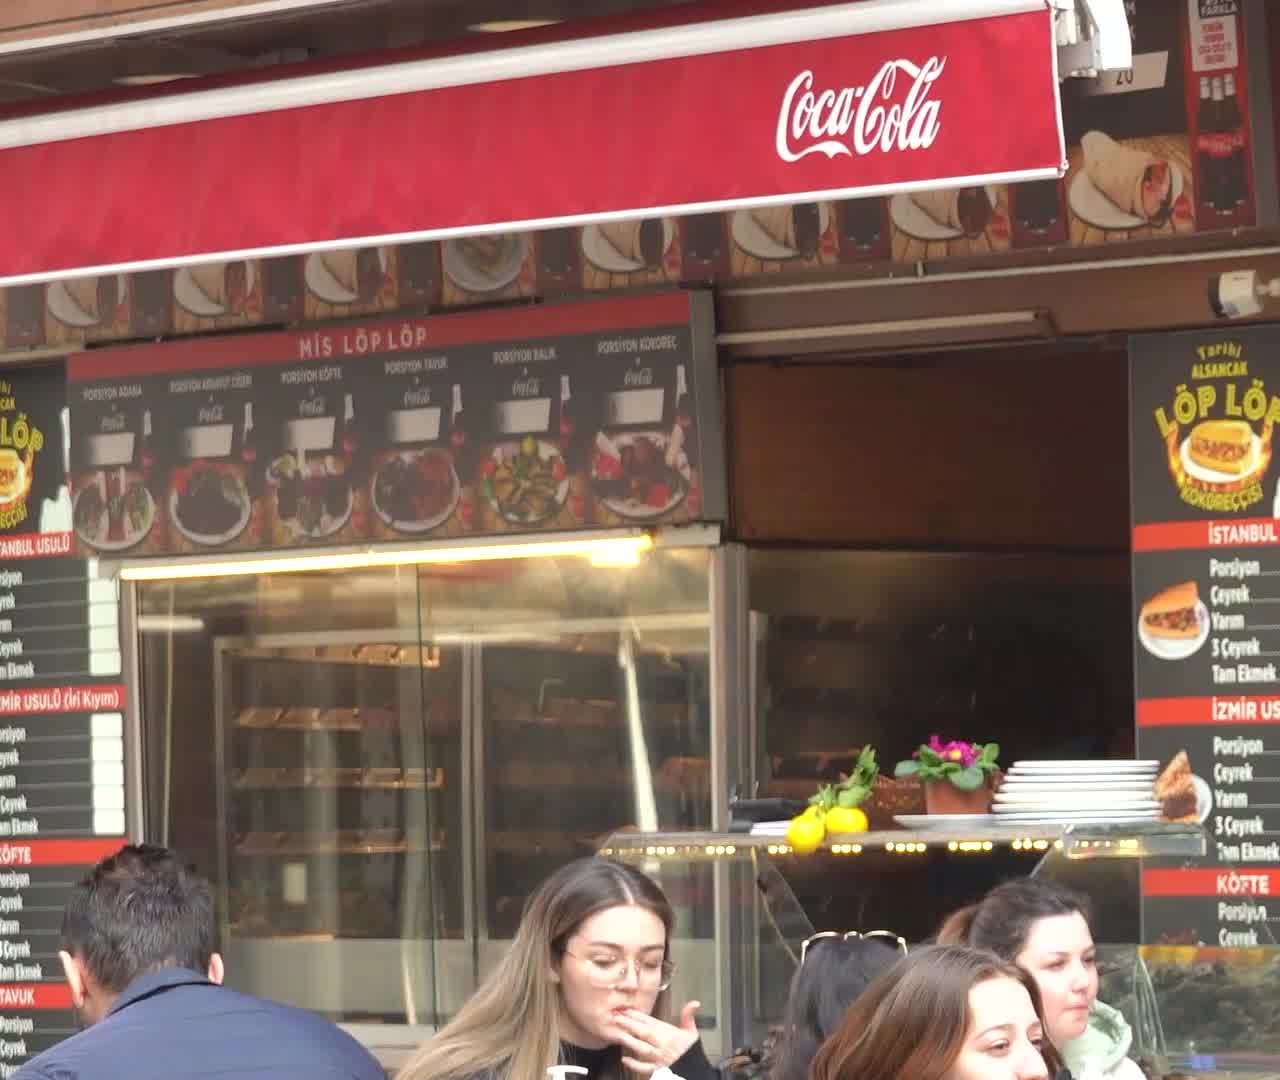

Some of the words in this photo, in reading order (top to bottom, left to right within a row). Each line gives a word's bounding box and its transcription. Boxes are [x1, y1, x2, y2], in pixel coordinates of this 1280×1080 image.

[776, 55, 948, 162] Coca-Cola
[299, 335, 334, 359] MİS
[344, 329, 382, 354] LÖP
[388, 324, 427, 350] LÖP
[1197, 341, 1242, 360] Tarihi
[1191, 360, 1249, 380] ALSANCAK
[1155, 384, 1217, 438] LÖP
[36, 533, 71, 554] USULÜ
[1208, 520, 1278, 545] İSTANBUL
[1208, 557, 1261, 580] Porsiyon
[1210, 584, 1251, 607] Çeyrek
[1211, 612, 1245, 631] Yarım
[1221, 637, 1260, 660] Çeyrek
[8, 659, 35, 680] Ekmek
[1211, 665, 1236, 685] Tam
[1237, 662, 1278, 684] Ekmek
[24, 687, 62, 709] USULÜ
[82, 689, 120, 711] Kıyım)
[1212, 696, 1258, 721] İZMİR
[1213, 735, 1264, 759] Porsiyon
[1213, 762, 1254, 785] Çeyrek
[1214, 789, 1249, 809] Yarım
[12, 816, 40, 836] Ekmek
[1214, 816, 1224, 834] 3
[1224, 816, 1265, 838] Çeyrek
[1241, 841, 1280, 862] Ekmek
[1216, 871, 1271, 895] KÖFTE
[15, 962, 43, 981] Ekmek
